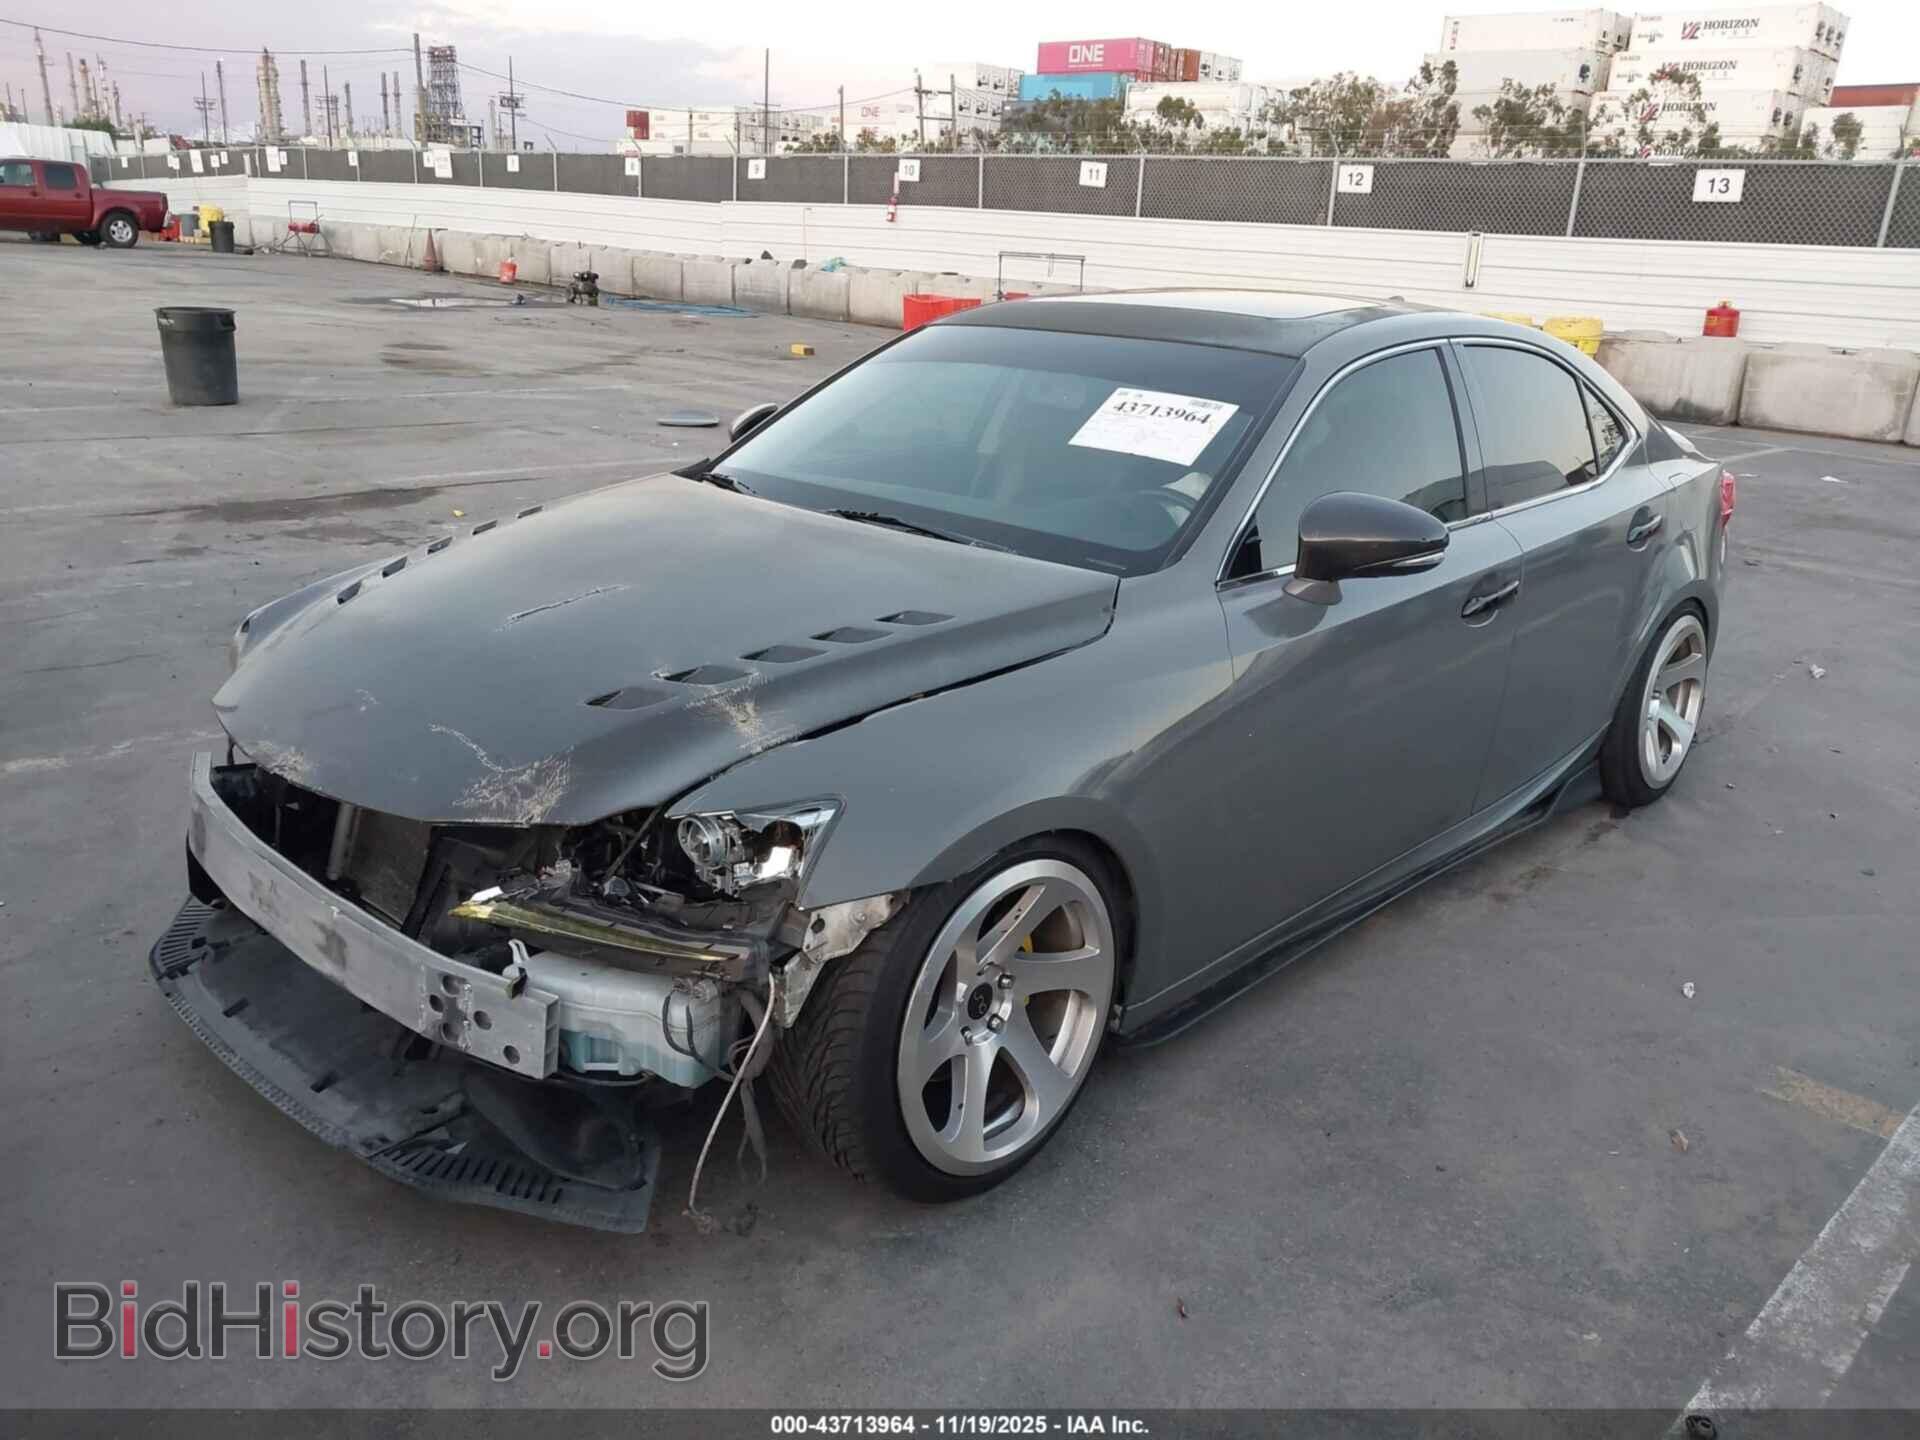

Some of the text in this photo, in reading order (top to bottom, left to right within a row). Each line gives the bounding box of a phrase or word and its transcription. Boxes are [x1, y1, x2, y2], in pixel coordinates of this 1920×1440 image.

[1703, 18, 1760, 30] HORIZON
[1068, 44, 1104, 63] ONE
[1682, 60, 1738, 71] HORIZON
[904, 165, 914, 176] 10
[1089, 168, 1099, 180] 11
[1348, 172, 1364, 186] 12
[1708, 178, 1730, 194] 13
[1113, 401, 1212, 424] 43713964
